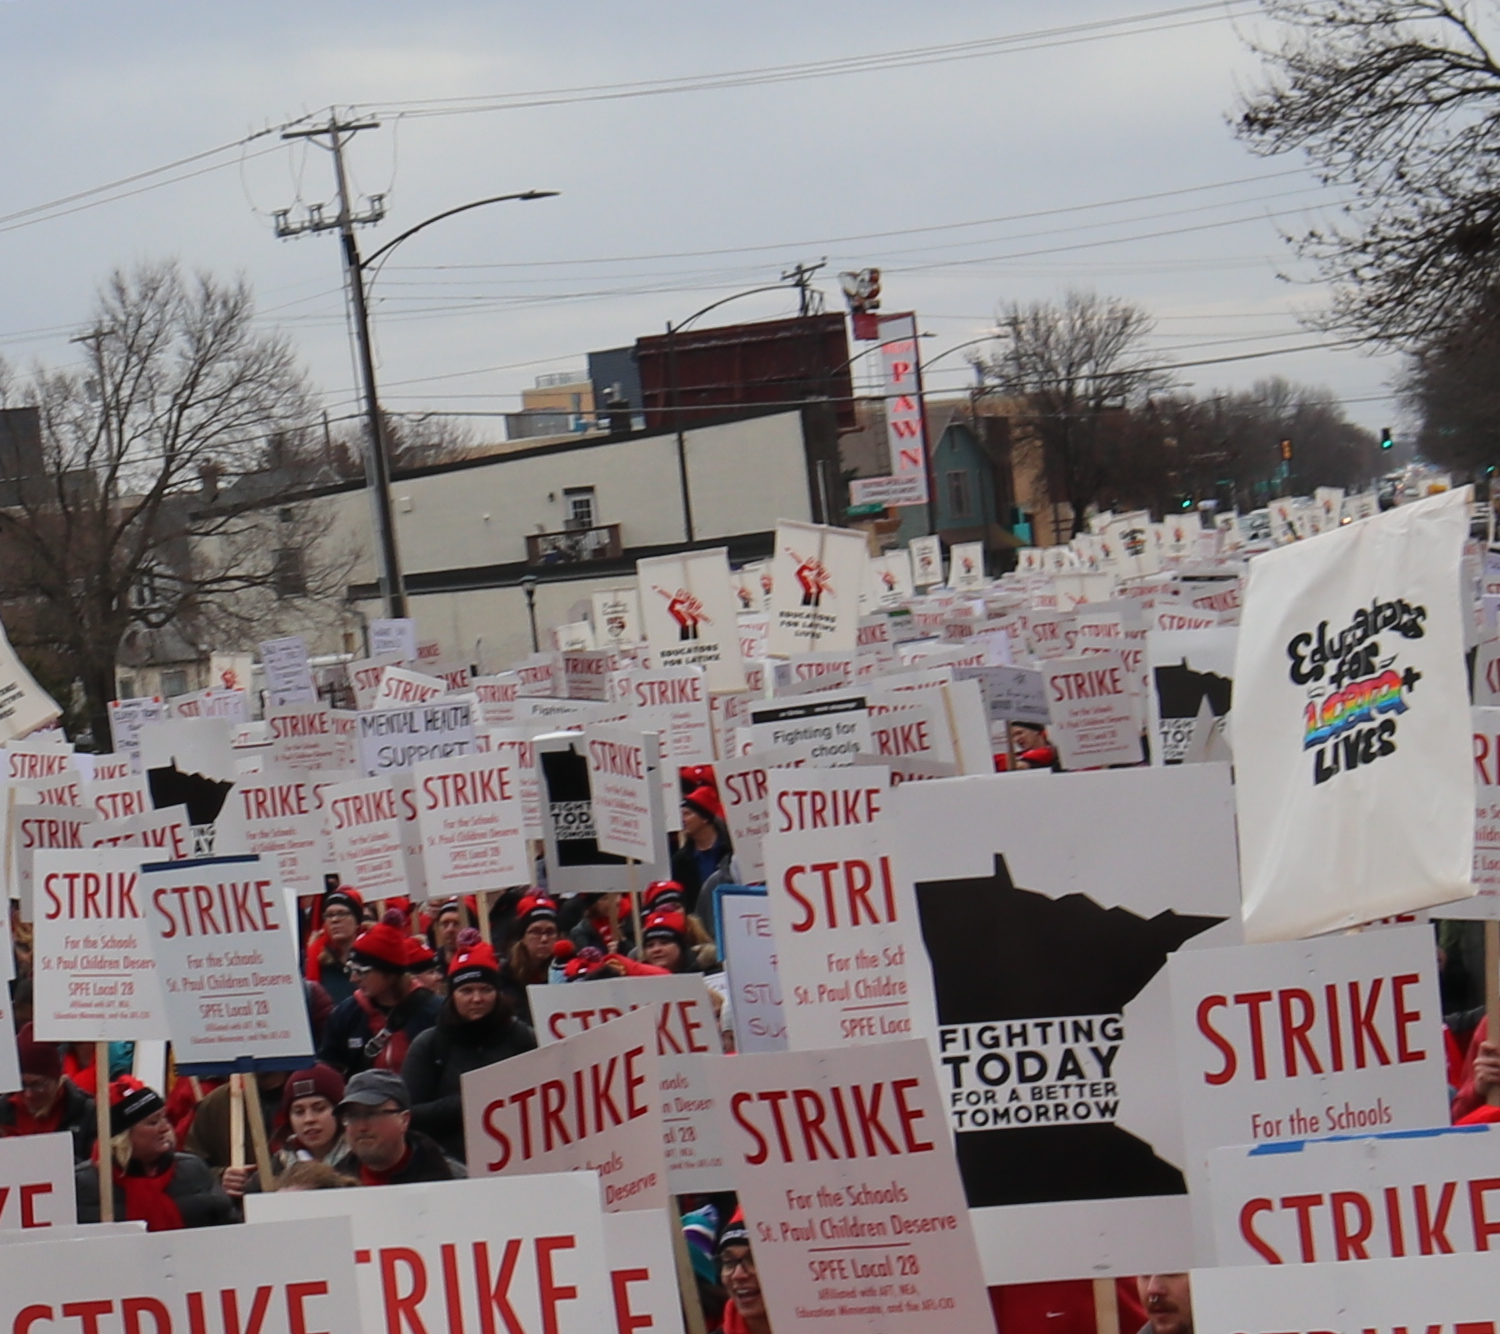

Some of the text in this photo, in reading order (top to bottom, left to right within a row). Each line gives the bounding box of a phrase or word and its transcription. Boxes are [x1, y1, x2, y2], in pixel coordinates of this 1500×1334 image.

[891, 362, 922, 469] PAWN
[1287, 596, 1427, 685] Educators
[635, 677, 702, 707] STRIKE
[1050, 667, 1123, 702] STRIKE
[361, 706, 470, 739] MENTAL HEALTH
[378, 741, 470, 768] SUPPORT
[1315, 717, 1396, 785] LIVES
[423, 767, 512, 810] STRIKE
[153, 880, 279, 938] STRIKE
[940, 1017, 1123, 1052] FIGHTING
[1197, 974, 1426, 1085] STRIKE
[942, 1045, 1119, 1088] TODAY
[482, 1046, 647, 1172] STRIKE
[951, 1082, 1117, 1107] FOR A BETTER
[953, 1095, 1119, 1127] TOMORROW
[731, 1078, 934, 1165] STRIKE
